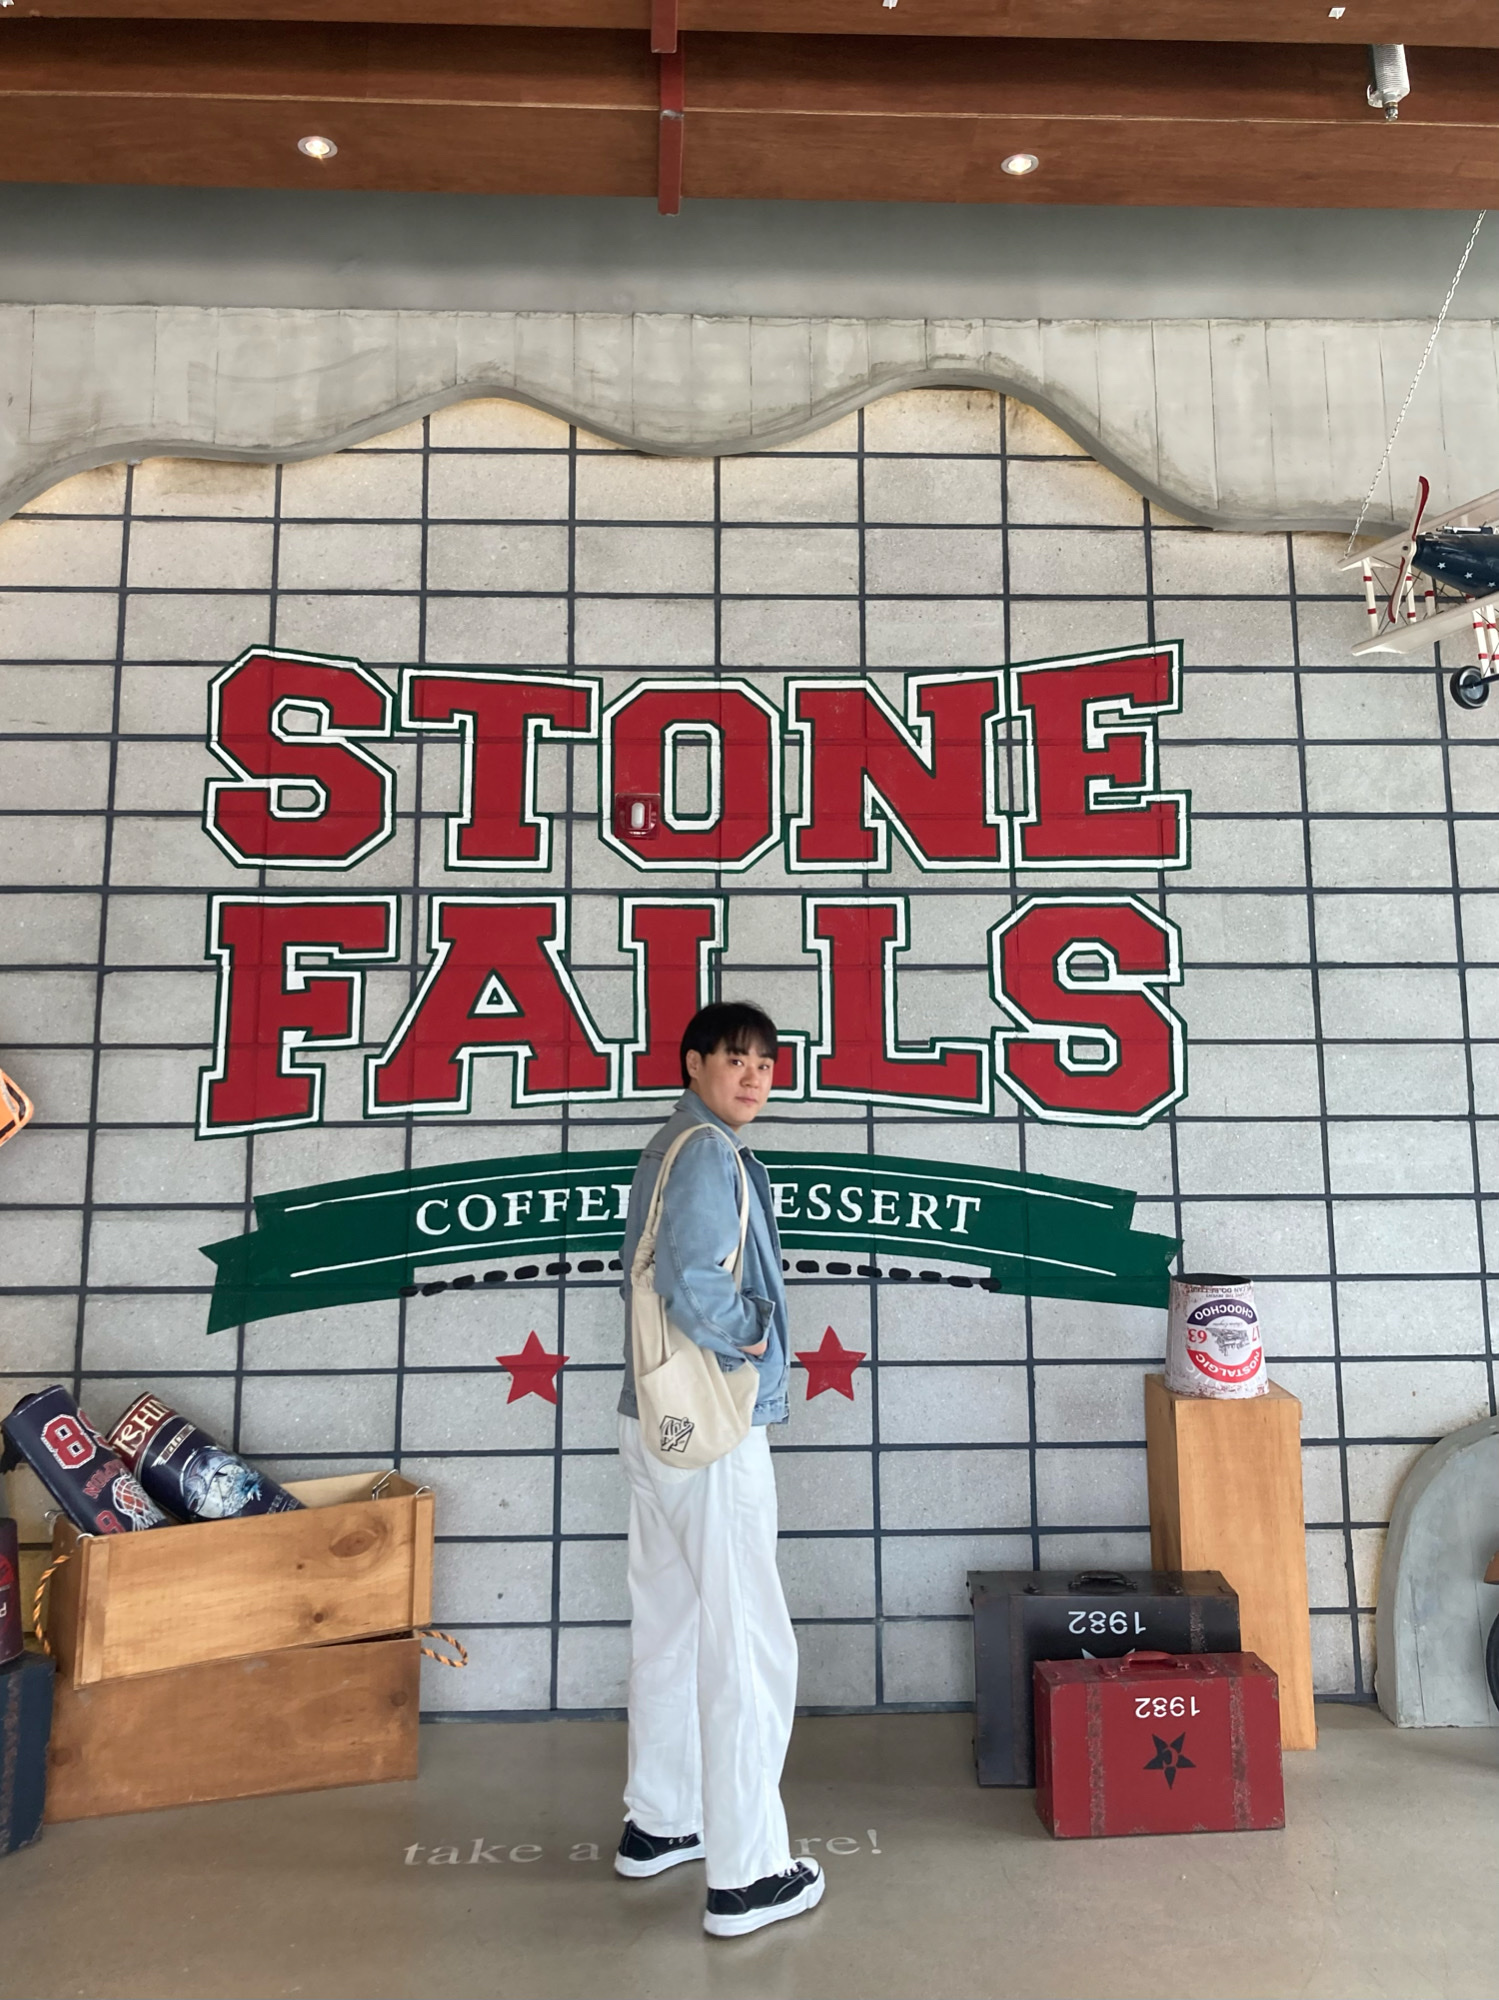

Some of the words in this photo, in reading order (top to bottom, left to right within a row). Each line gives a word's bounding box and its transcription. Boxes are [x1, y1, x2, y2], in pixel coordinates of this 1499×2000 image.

[203, 640, 1191, 872] STONE
[769, 1182, 981, 1234] ESSERT
[1194, 1304, 1254, 1320] CHOOCHOO
[1195, 1351, 1260, 1377] NOSTALGIC
[113, 1399, 172, 1457] ISHIN
[1067, 1610, 1146, 1635] 1982
[1134, 1696, 1200, 1718] 1982
[403, 1837, 544, 1866] take
[568, 1842, 600, 1861] a
